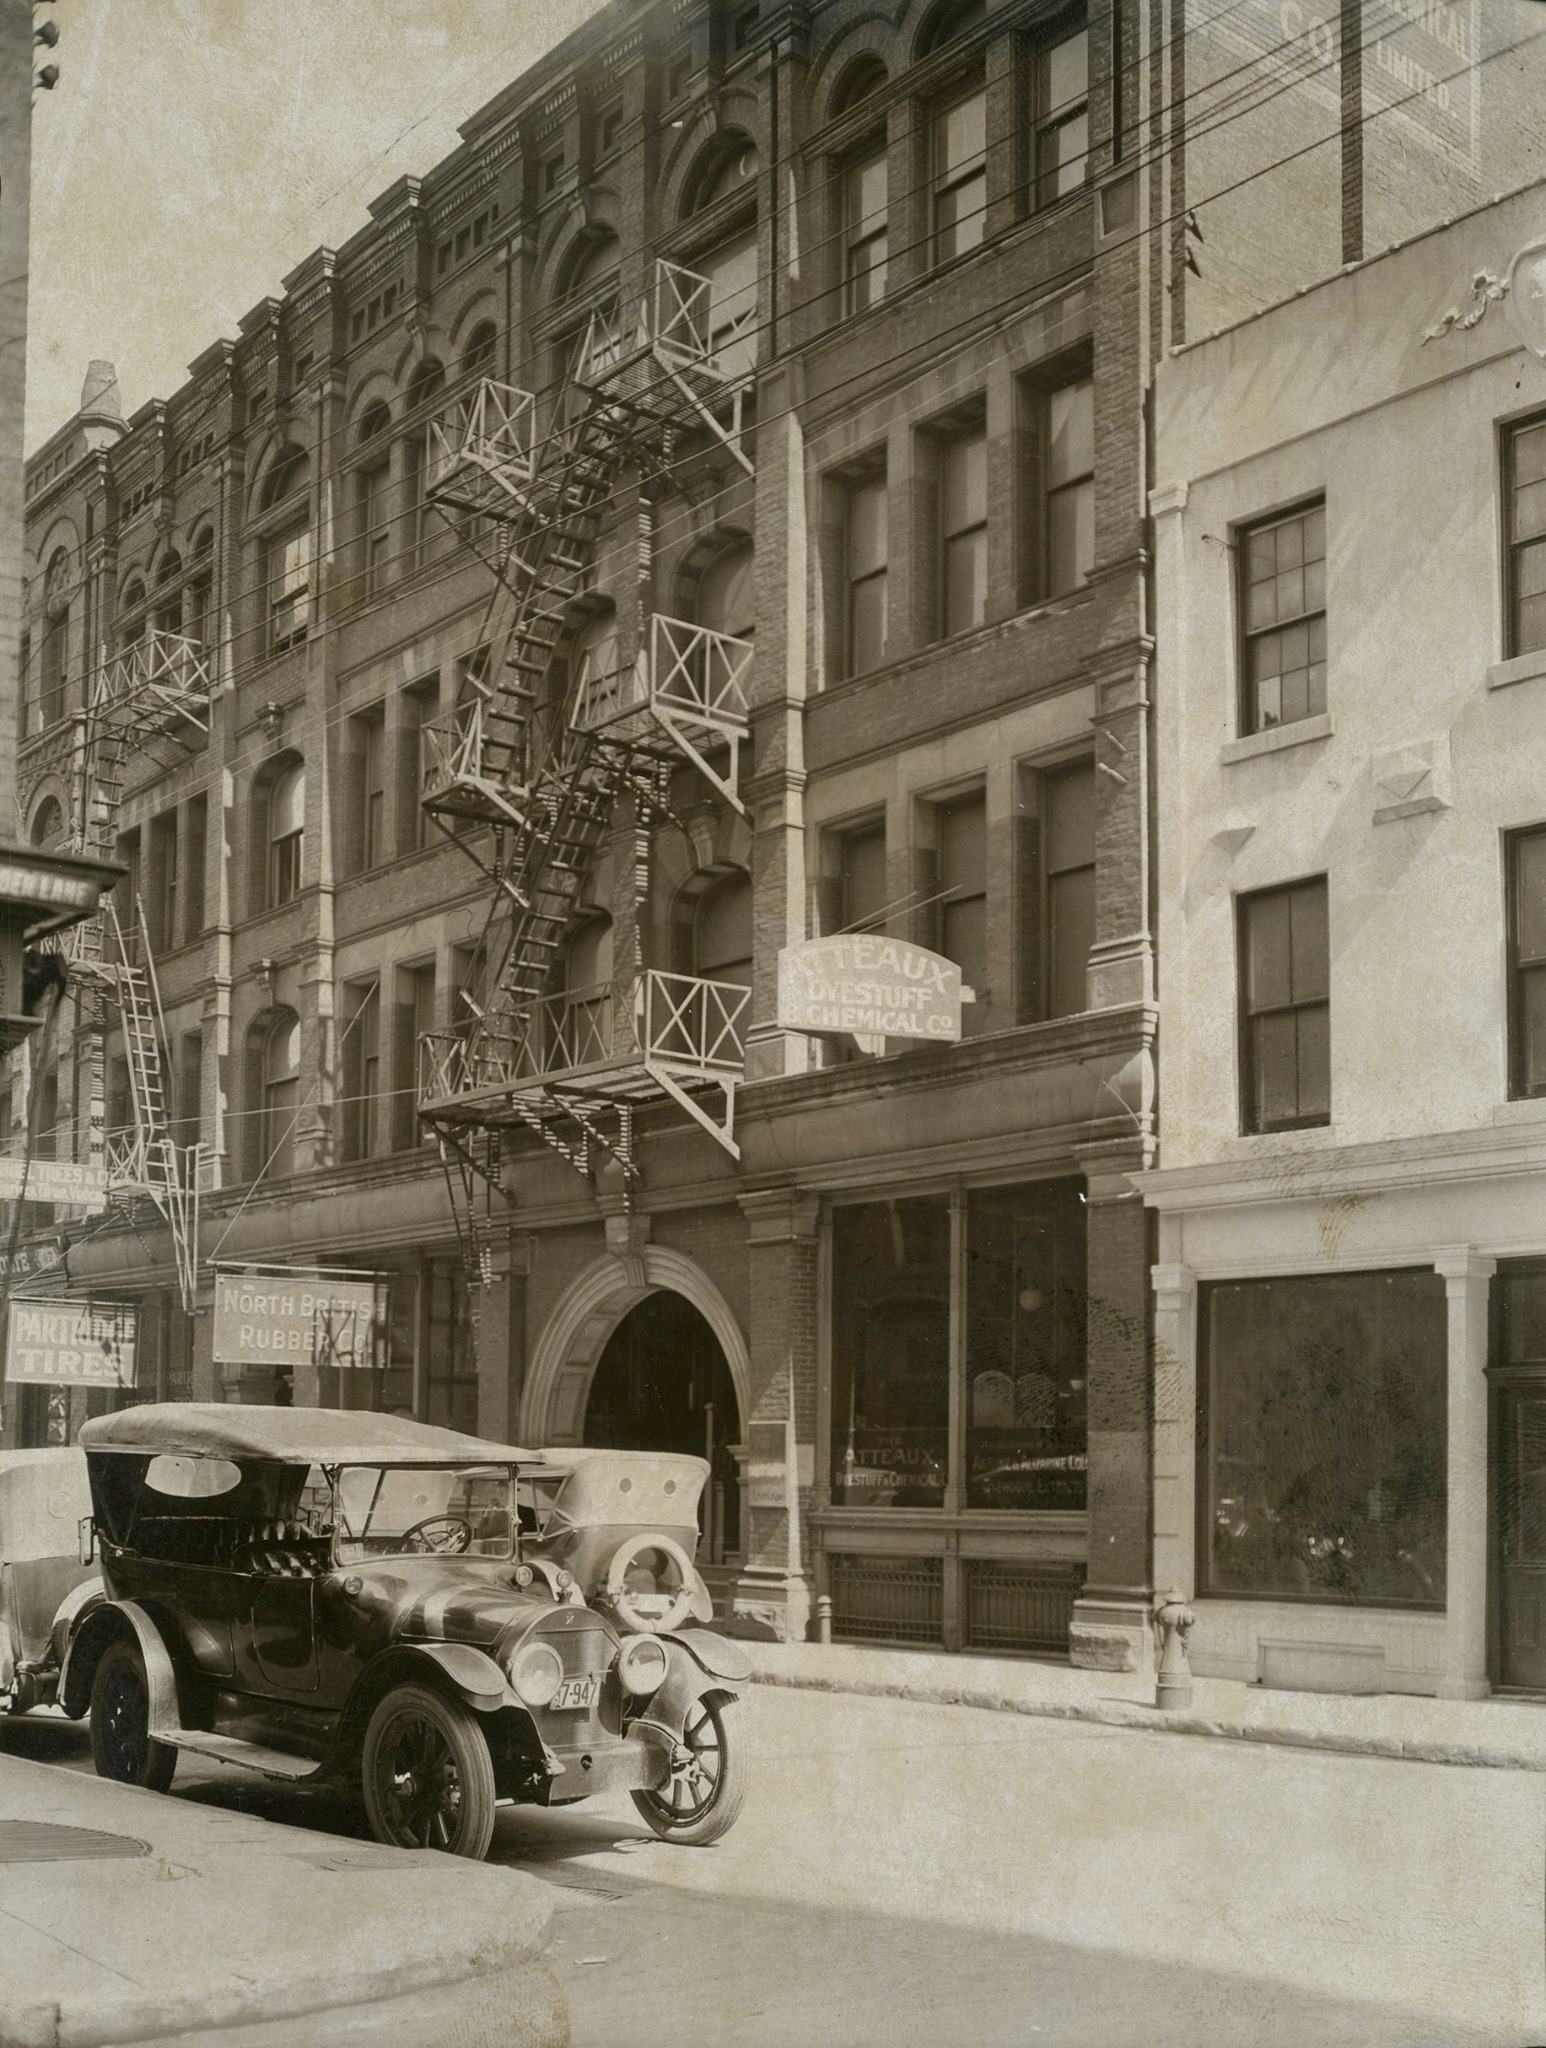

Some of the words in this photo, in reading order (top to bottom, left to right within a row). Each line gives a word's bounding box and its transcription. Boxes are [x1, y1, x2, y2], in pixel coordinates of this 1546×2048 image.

[797, 943, 954, 994] TEAUX
[806, 1003, 923, 1033] CHEMICAL
[223, 1289, 296, 1316] NORTH
[239, 1324, 330, 1352] RUBBER
[16, 1348, 118, 1377] TIRES
[842, 1448, 936, 1465] ATTEAUX
